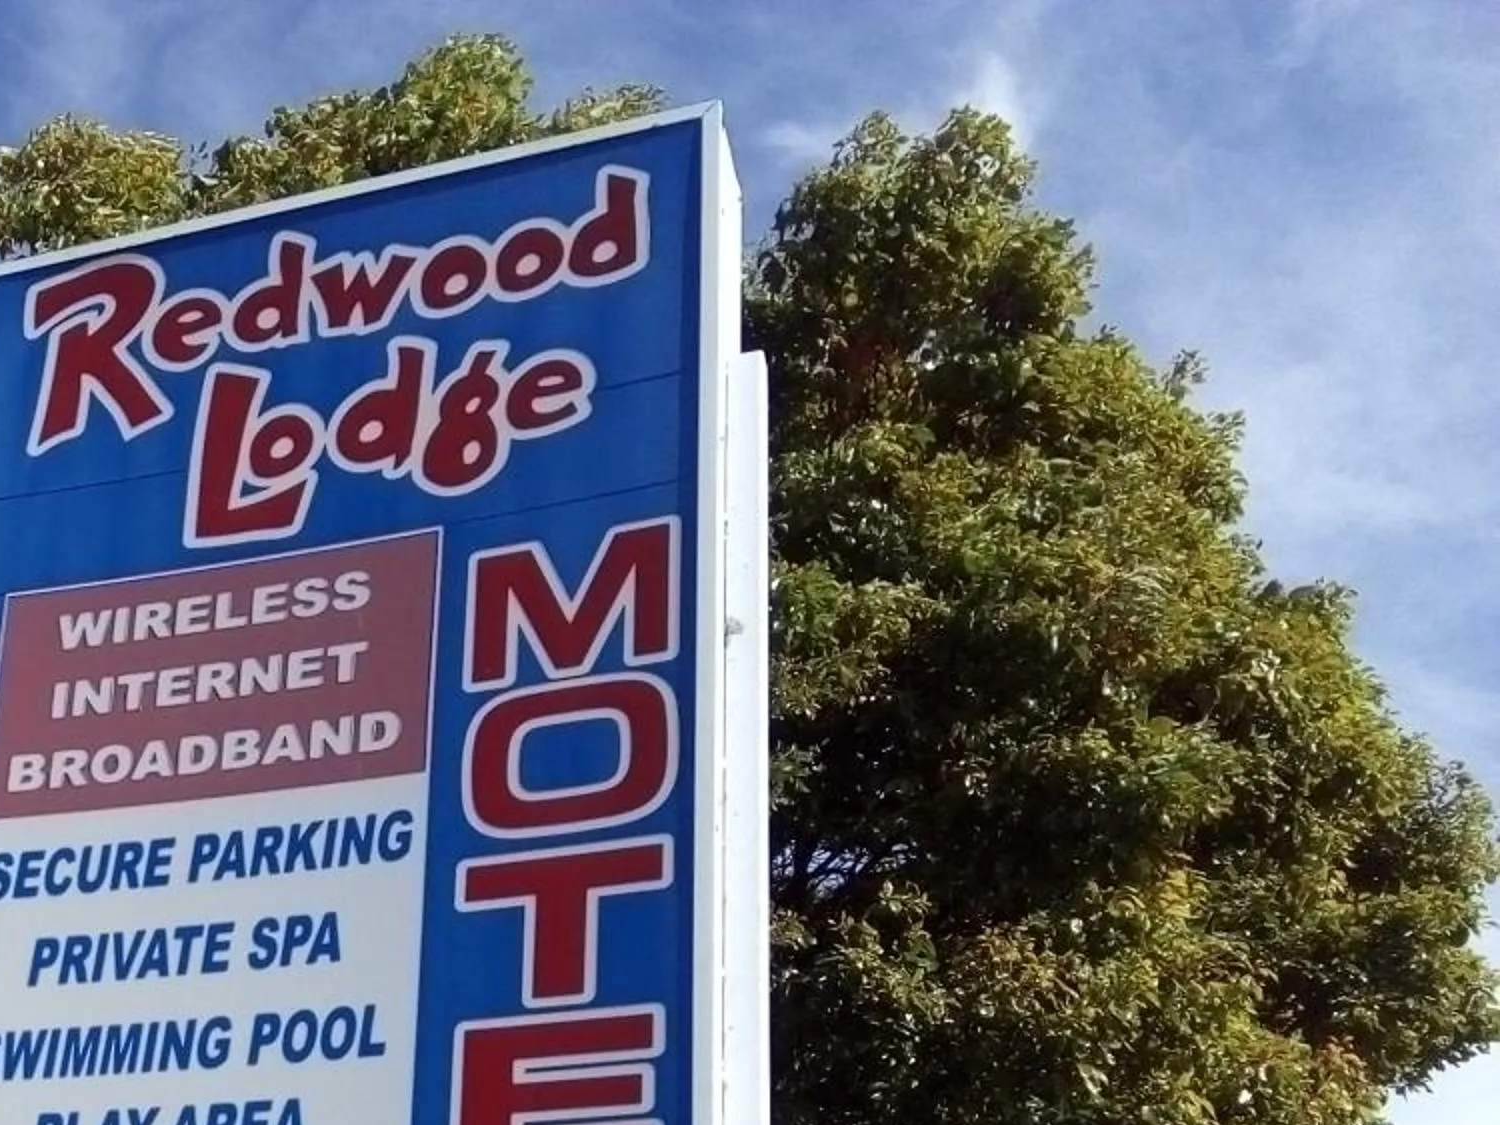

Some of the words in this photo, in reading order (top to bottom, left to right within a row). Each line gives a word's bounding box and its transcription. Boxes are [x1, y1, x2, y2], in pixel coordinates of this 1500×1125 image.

[24, 164, 650, 457] Redwood
[184, 335, 595, 548] Lodge
[58, 571, 372, 652] WIRELESS
[51, 642, 369, 719] INTERNET
[7, 710, 401, 793] BROADBAND
[187, 809, 414, 882] PARKING
[27, 921, 235, 987] PRIVATE
[247, 911, 342, 970] SPA
[247, 1004, 386, 1065] POOL
